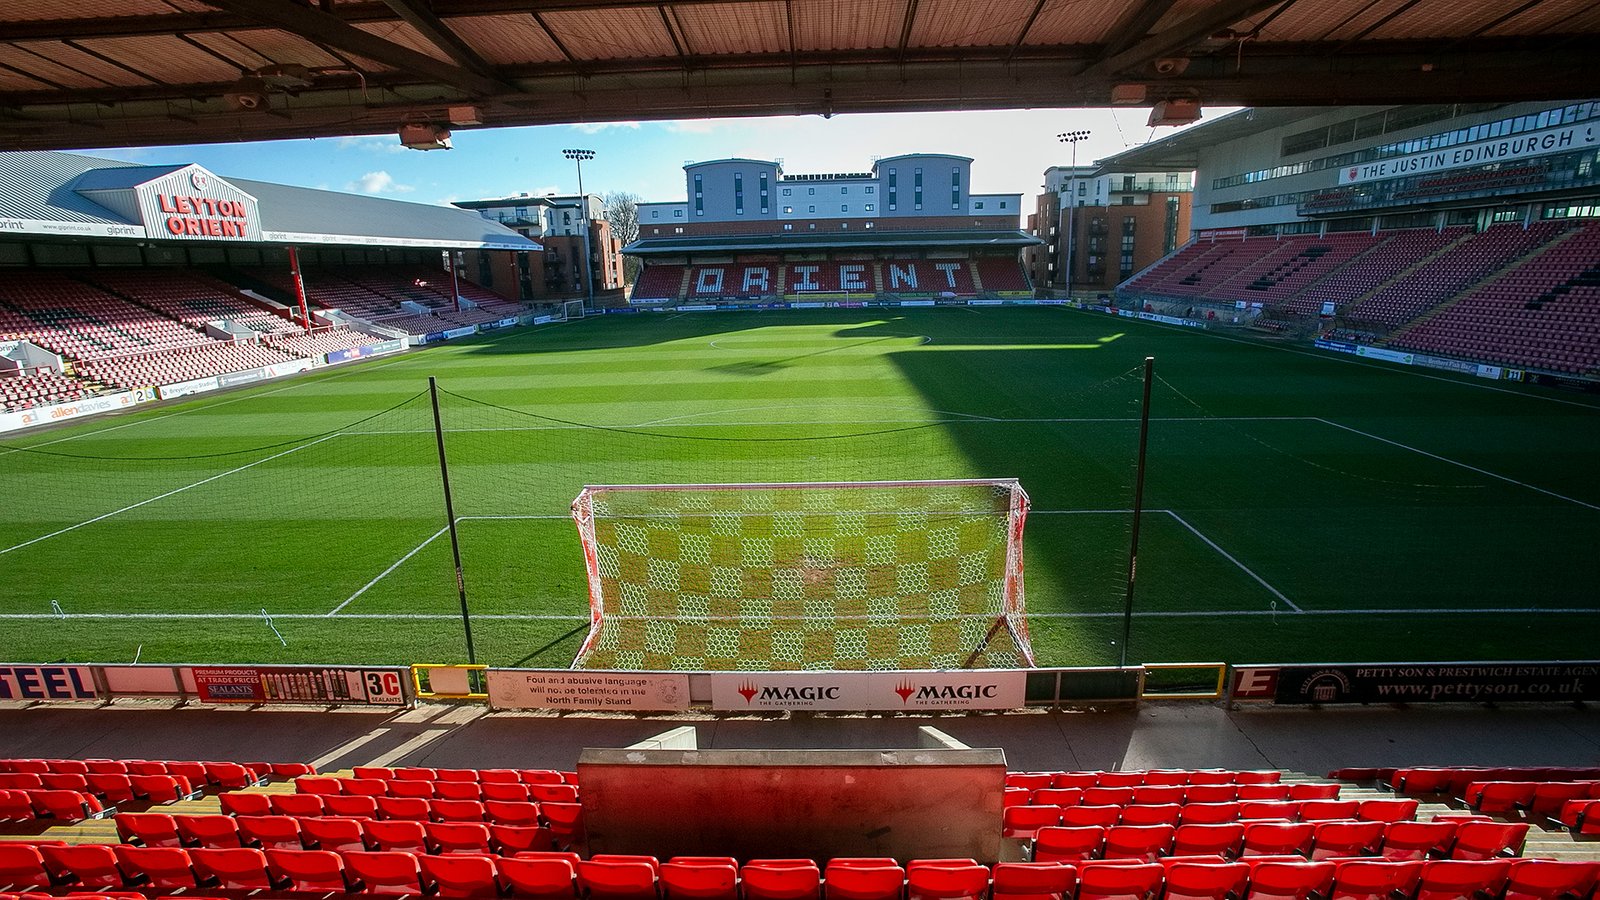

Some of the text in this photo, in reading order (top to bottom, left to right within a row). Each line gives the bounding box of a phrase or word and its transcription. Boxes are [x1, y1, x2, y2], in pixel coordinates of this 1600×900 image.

[1362, 164, 1386, 178] THE
[1391, 153, 1445, 173] JUSTIN
[1453, 130, 1573, 164] EDINBURGH
[159, 193, 247, 218] LEYTON
[107, 226, 135, 235] giprint
[167, 216, 247, 238] ORIENT
[136, 391, 144, 401] 2
[1355, 668, 1396, 678] PETTY
[1397, 668, 1424, 677] SON
[1426, 668, 1436, 677] &
[1438, 667, 1515, 677] PRESTWICH
[1516, 666, 1560, 676] ESTATE
[208, 685, 253, 694] SEALANTS
[367, 673, 399, 696] 3C
[567, 677, 603, 685] abusive
[605, 678, 647, 687] language
[1377, 678, 1584, 700] www.pettyson.co.uk
[759, 686, 841, 701] MAGIC
[916, 685, 998, 700] MAGIC
[573, 697, 602, 706] Family
